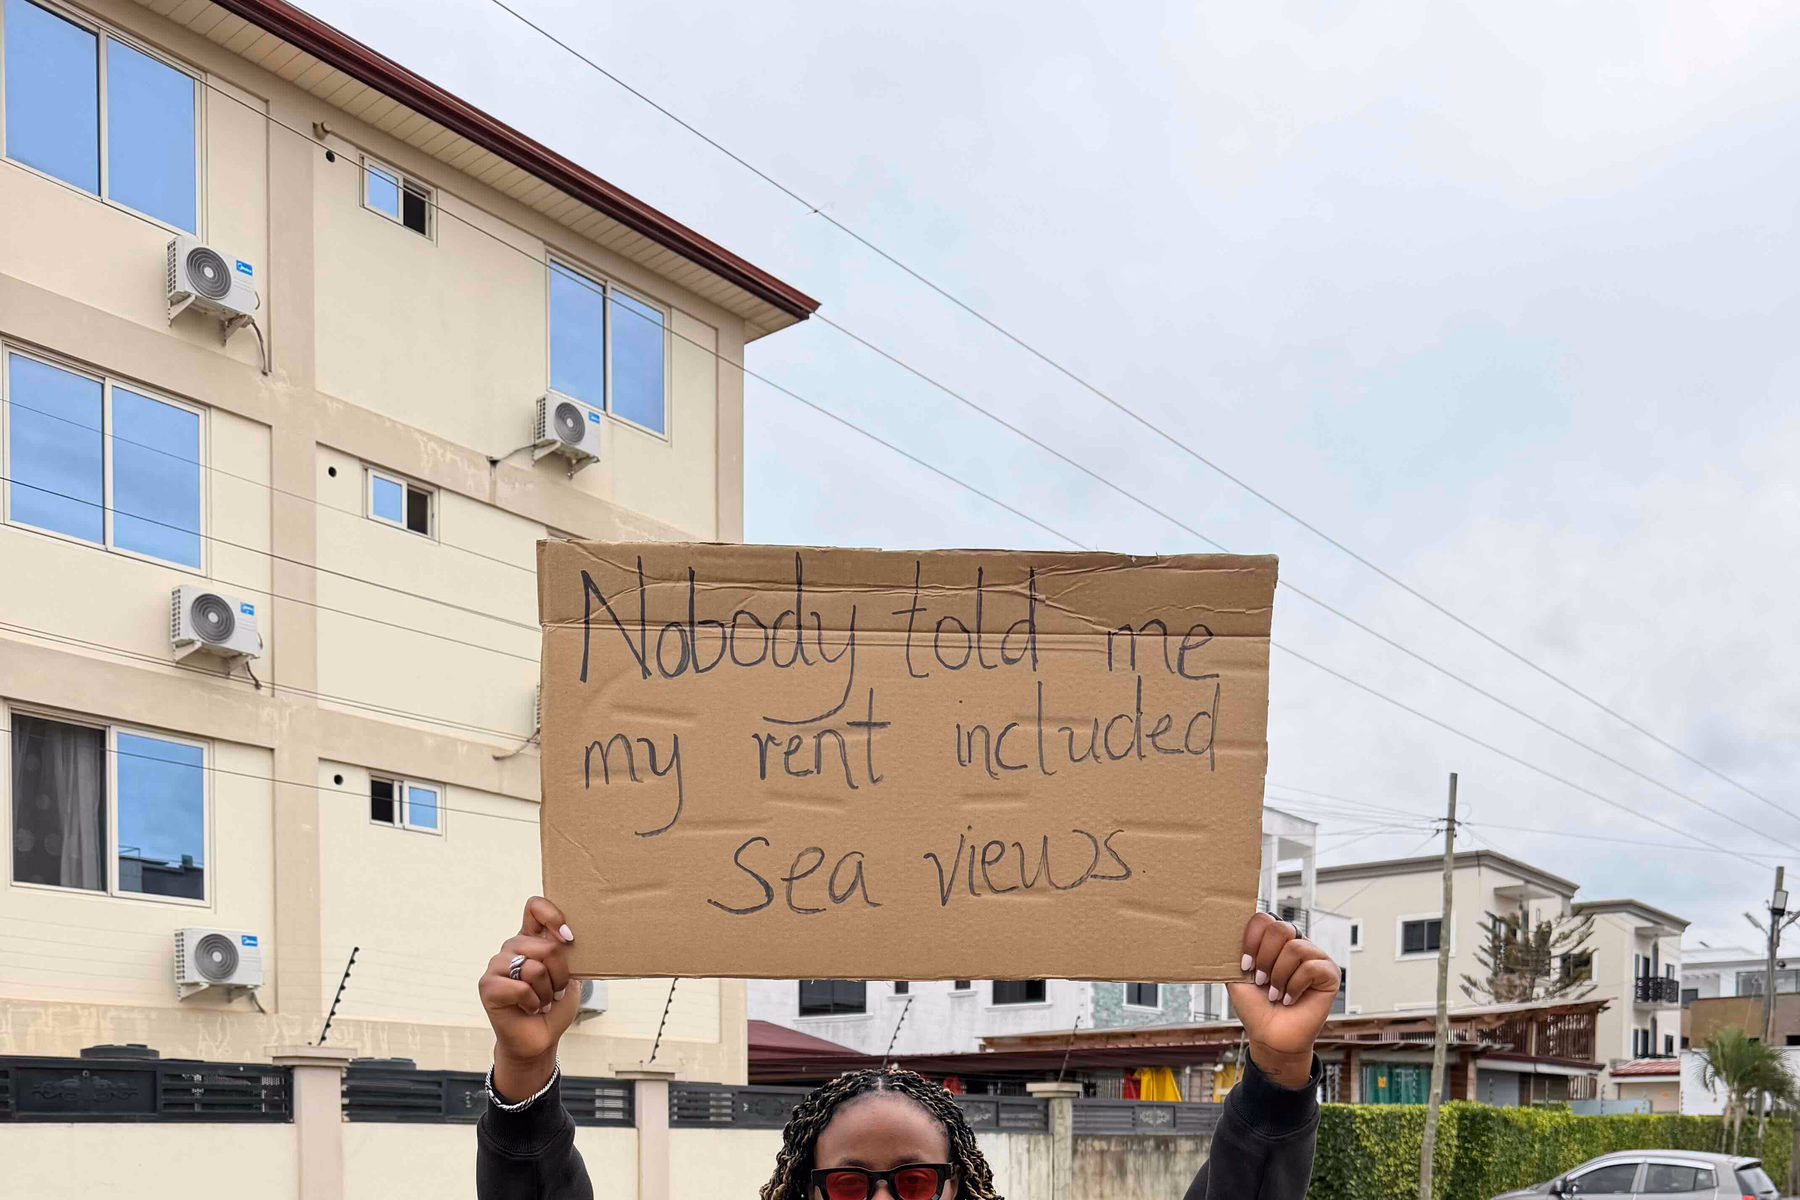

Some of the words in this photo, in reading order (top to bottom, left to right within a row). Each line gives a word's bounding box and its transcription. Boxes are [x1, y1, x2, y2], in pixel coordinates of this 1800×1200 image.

[580, 552, 857, 725] Nobody
[891, 560, 1038, 679] told
[1105, 618, 1220, 680] me
[584, 733, 684, 838] my
[752, 687, 892, 789] rent
[956, 675, 1221, 780] included
